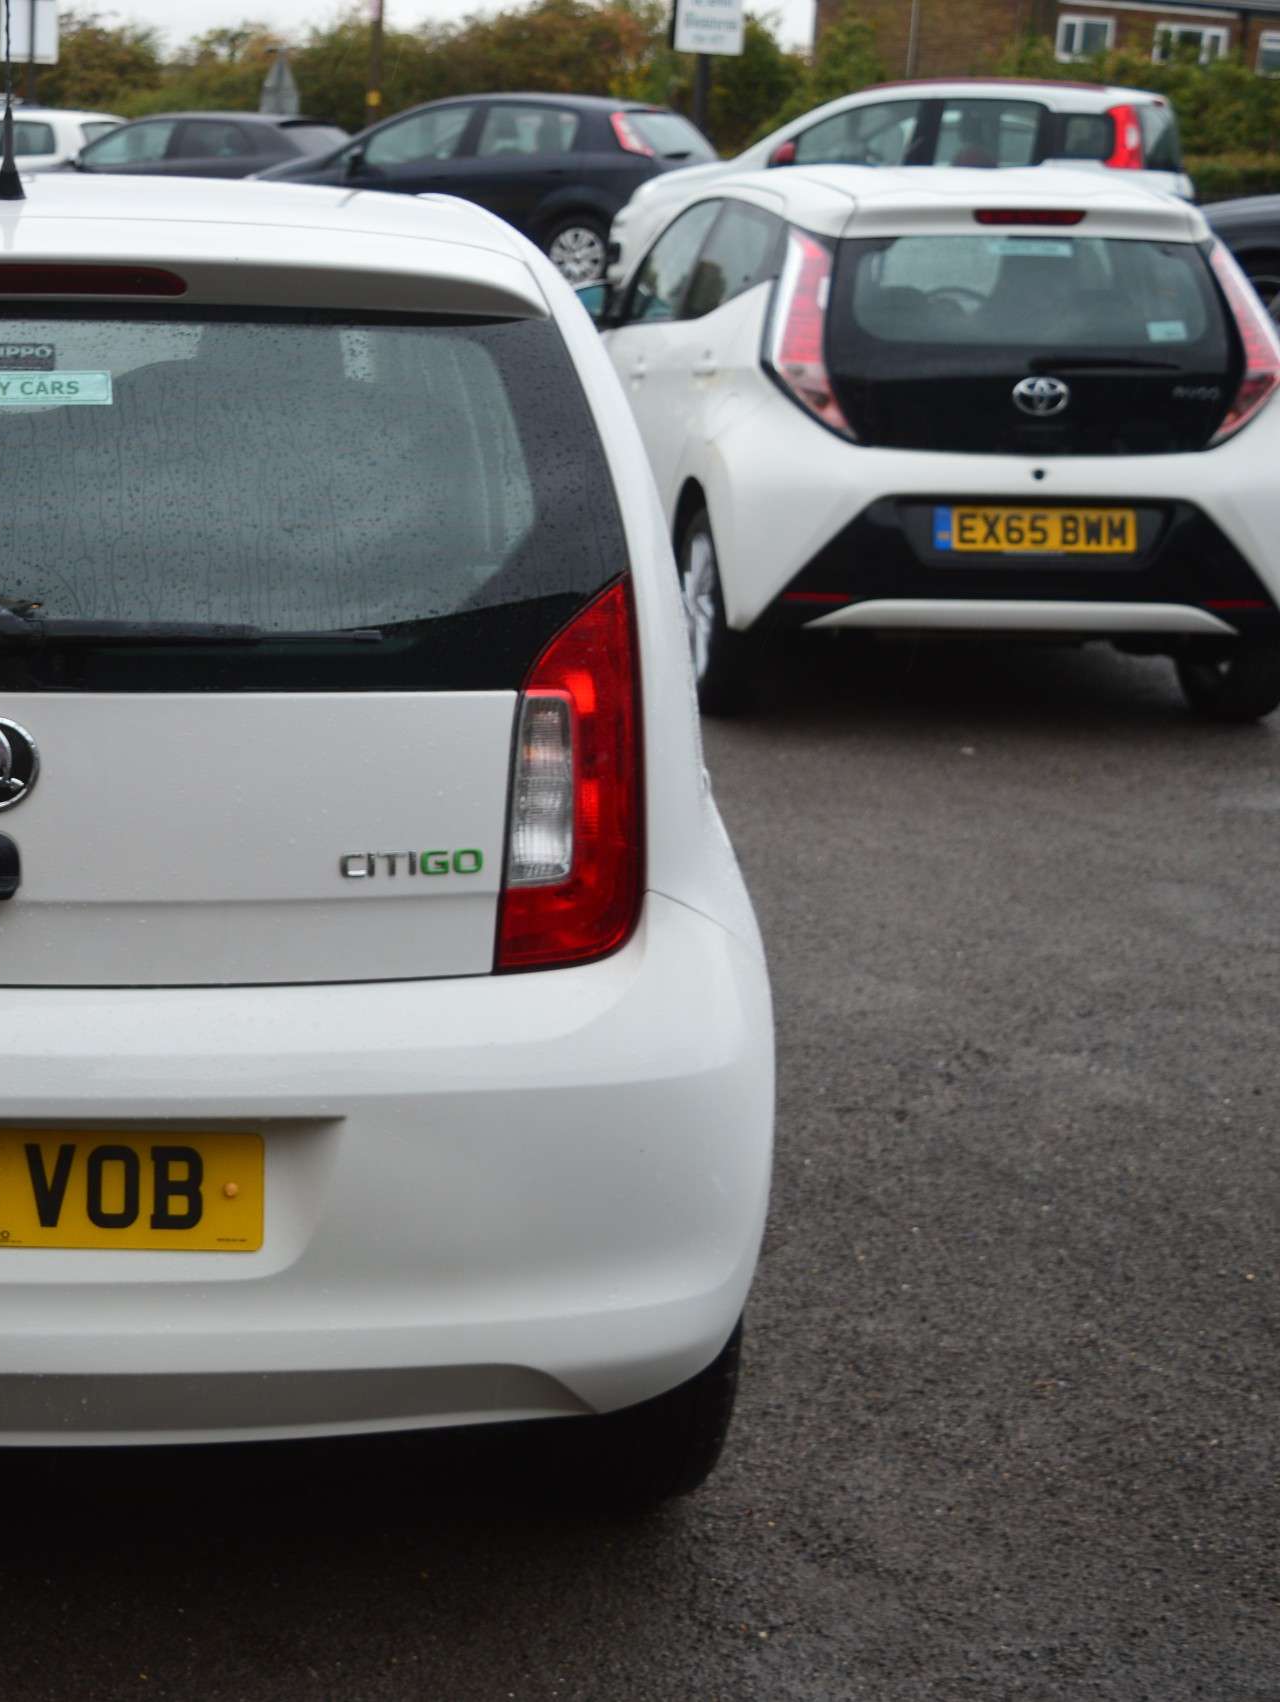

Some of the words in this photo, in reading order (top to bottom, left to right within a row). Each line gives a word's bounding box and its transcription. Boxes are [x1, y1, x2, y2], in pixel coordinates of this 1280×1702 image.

[19, 380, 80, 396] CARS
[958, 513, 1049, 545] EX65
[1060, 515, 1128, 547] BWM
[339, 848, 484, 878] CITIGO
[24, 1142, 205, 1231] VOB
